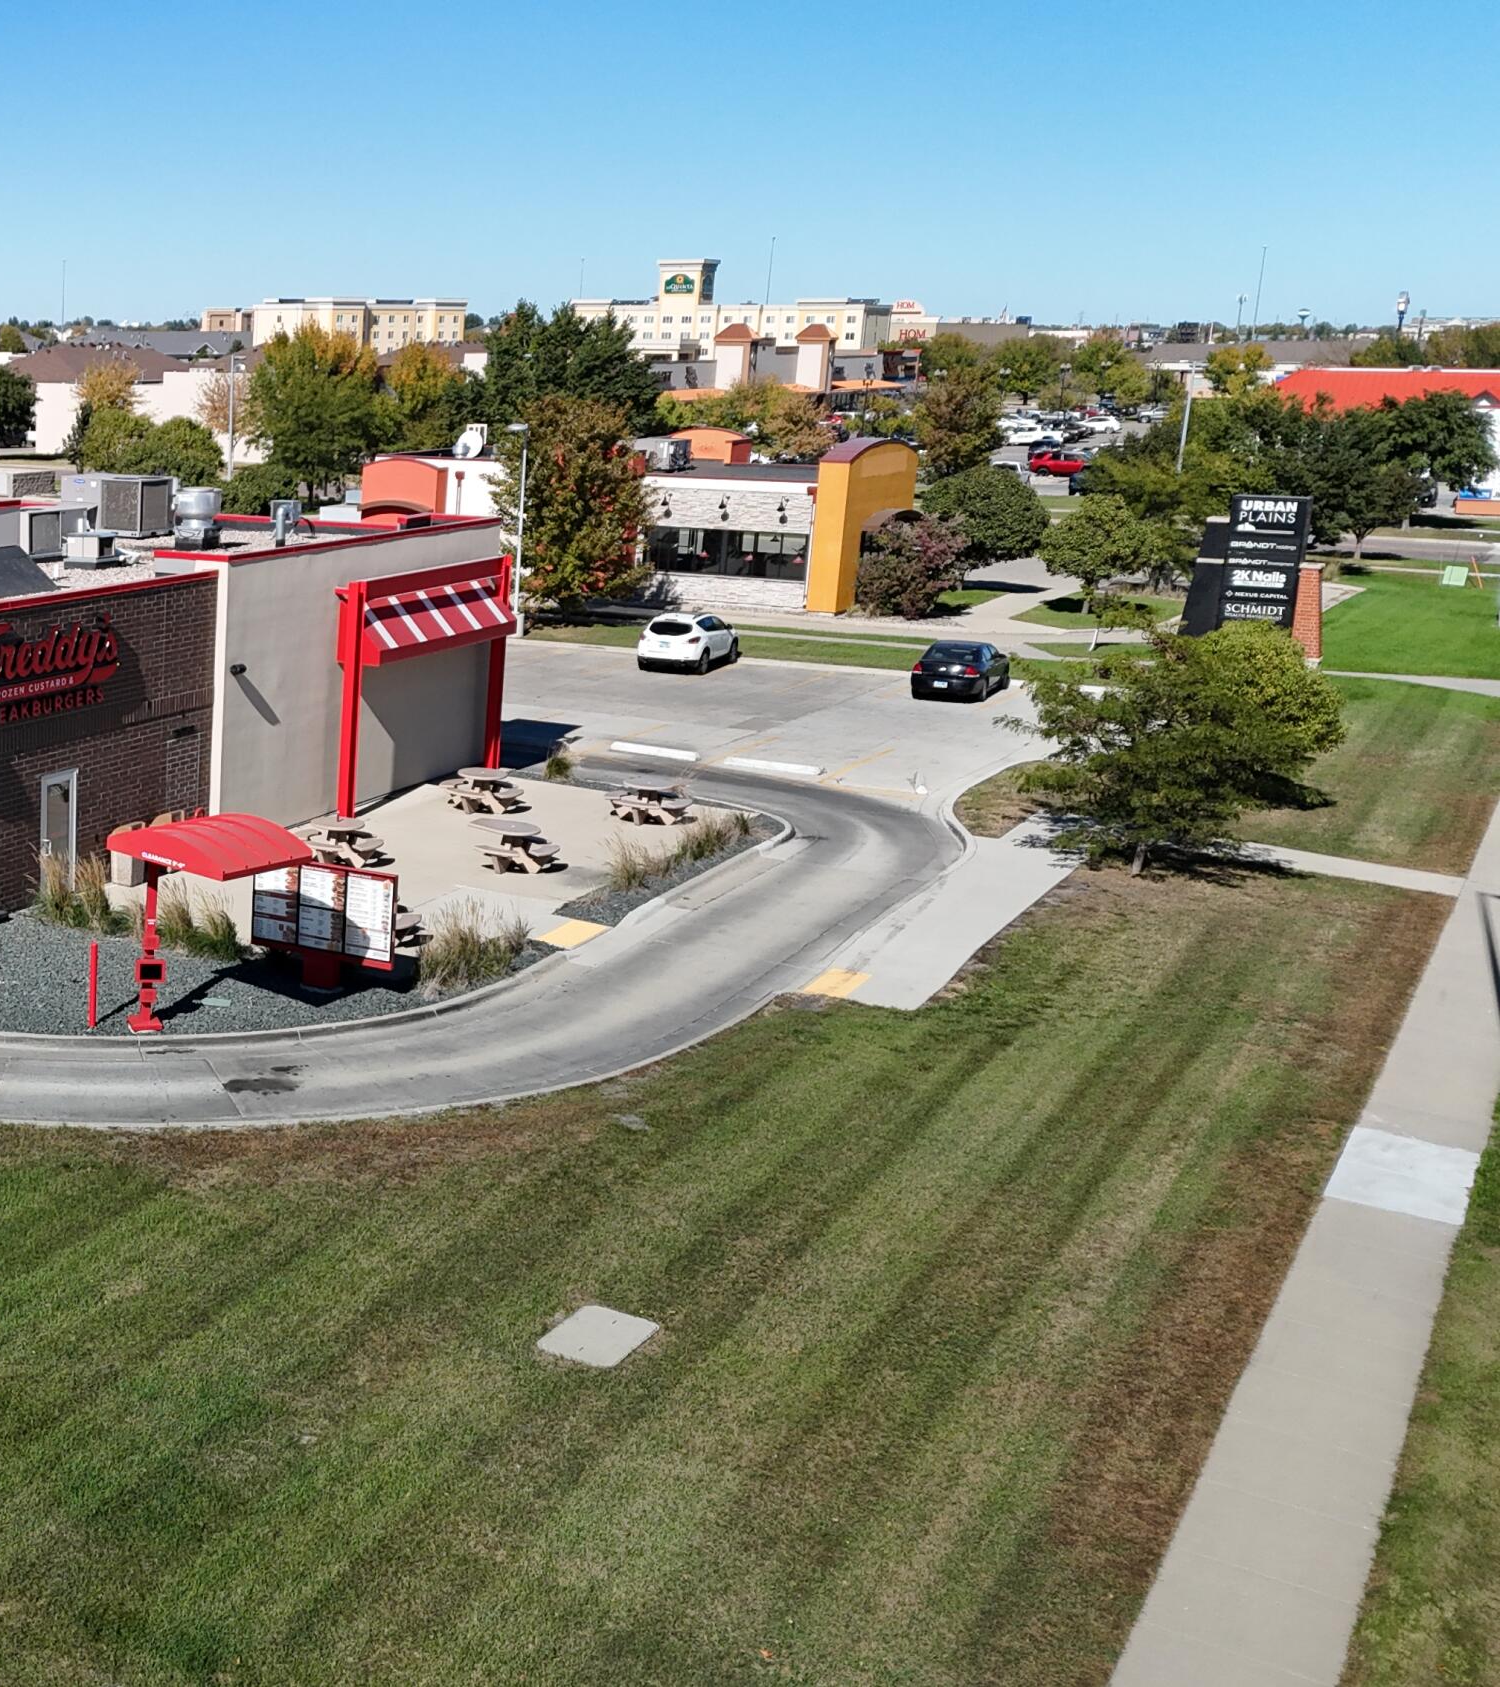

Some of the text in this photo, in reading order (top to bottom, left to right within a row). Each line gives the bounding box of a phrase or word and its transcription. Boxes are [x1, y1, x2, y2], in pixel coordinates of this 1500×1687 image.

[896, 301, 915, 309] HOM
[899, 328, 926, 341] HOM
[1241, 500, 1298, 512] URBAN
[1239, 511, 1296, 524] PLAINS
[1230, 541, 1276, 549] BRANDT
[1232, 569, 1287, 583] 2K Nails
[1225, 603, 1286, 616] SCHMIDT
[28, 677, 67, 693] CUSTARD
